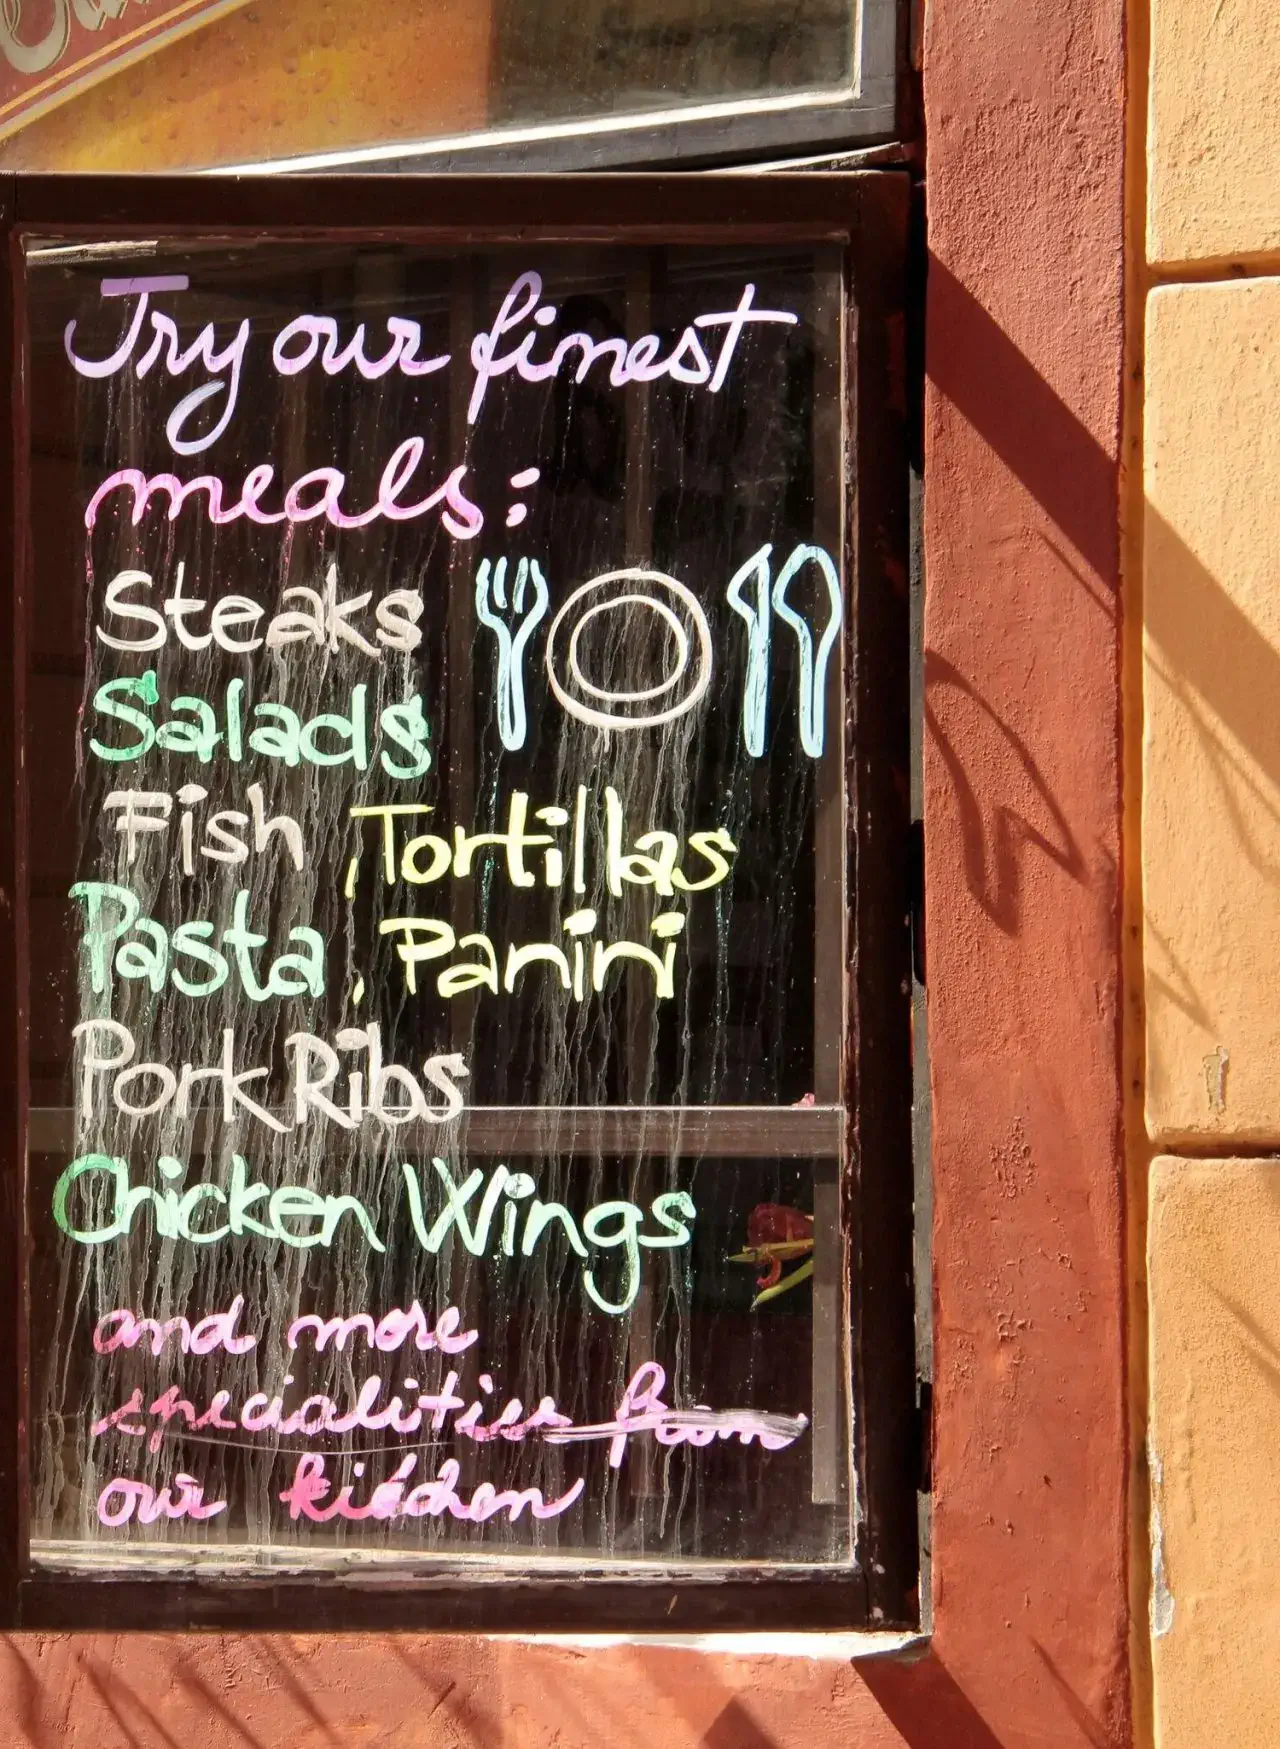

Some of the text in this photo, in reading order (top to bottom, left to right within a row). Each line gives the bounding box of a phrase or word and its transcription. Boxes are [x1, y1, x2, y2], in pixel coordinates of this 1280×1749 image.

[64, 270, 798, 456] Try our finest
[85, 436, 542, 540] meals:
[95, 562, 426, 658] Steaks
[89, 670, 434, 780] Salads
[103, 783, 305, 875] Fish
[72, 1020, 472, 1134] Pork Ribs
[52, 1152, 698, 1316] Chicken Wings
[92, 1294, 480, 1357] and more
[608, 1361, 810, 1470] from
[96, 1471, 227, 1527] our
